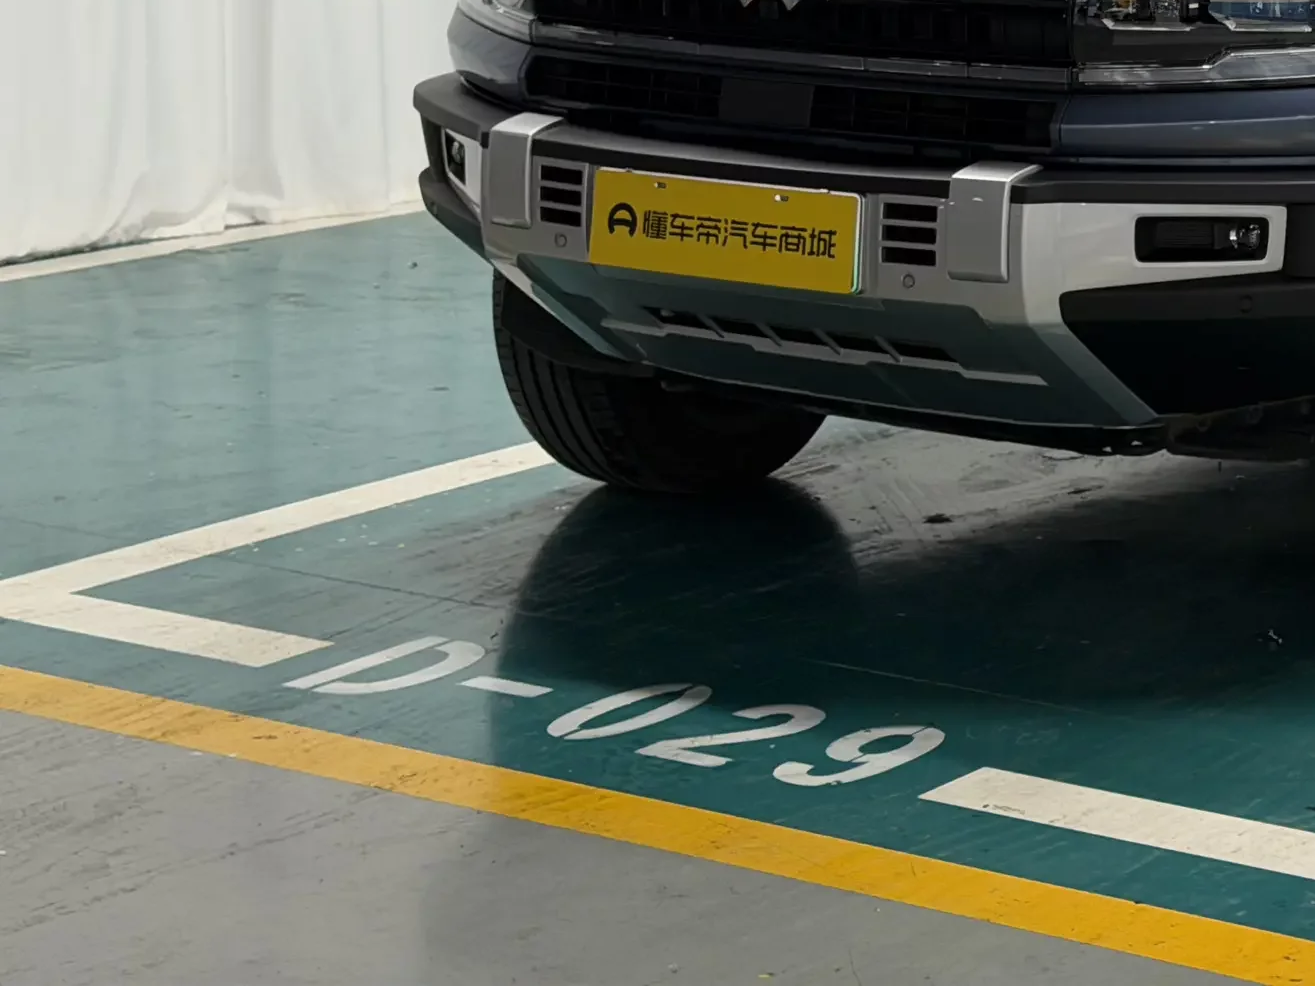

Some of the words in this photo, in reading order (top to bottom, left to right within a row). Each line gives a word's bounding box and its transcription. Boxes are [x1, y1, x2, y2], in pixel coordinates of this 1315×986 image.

[643, 210, 838, 258] 懂车帝汽车商城
[282, 636, 946, 787] D-029
